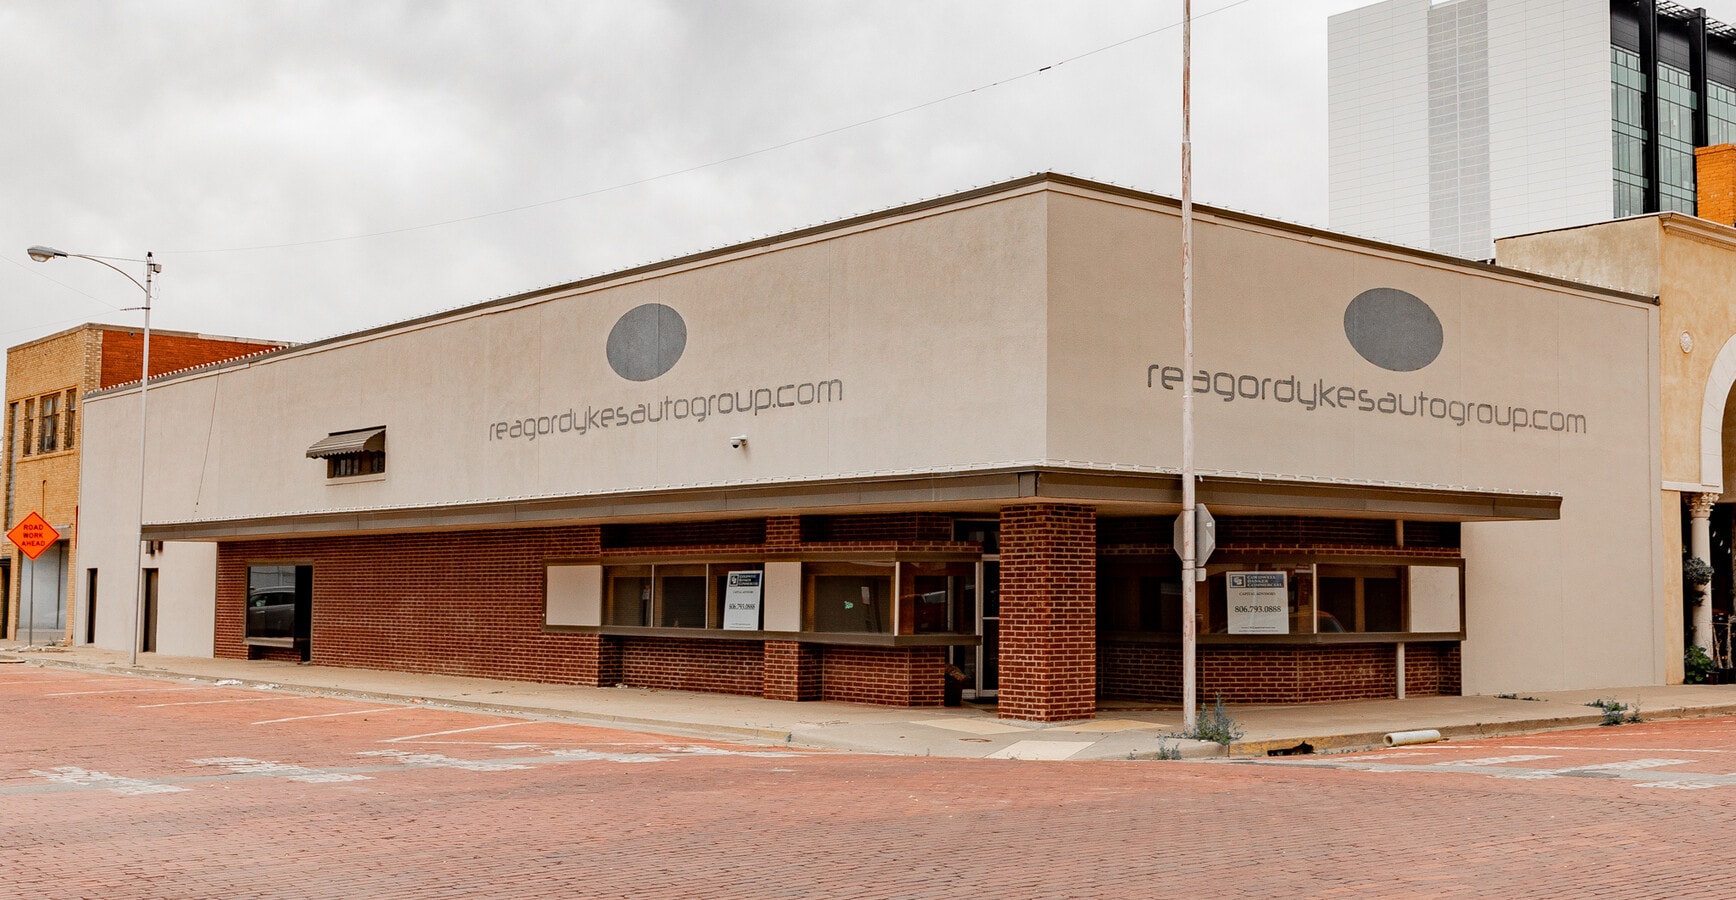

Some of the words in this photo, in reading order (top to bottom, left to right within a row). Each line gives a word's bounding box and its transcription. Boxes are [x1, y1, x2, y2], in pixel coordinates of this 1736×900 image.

[489, 378, 843, 441] reagordykesautogroup.com
[1147, 364, 1587, 434] reagordykesautogroup.com
[1234, 605, 1282, 613] 806.793.0888
